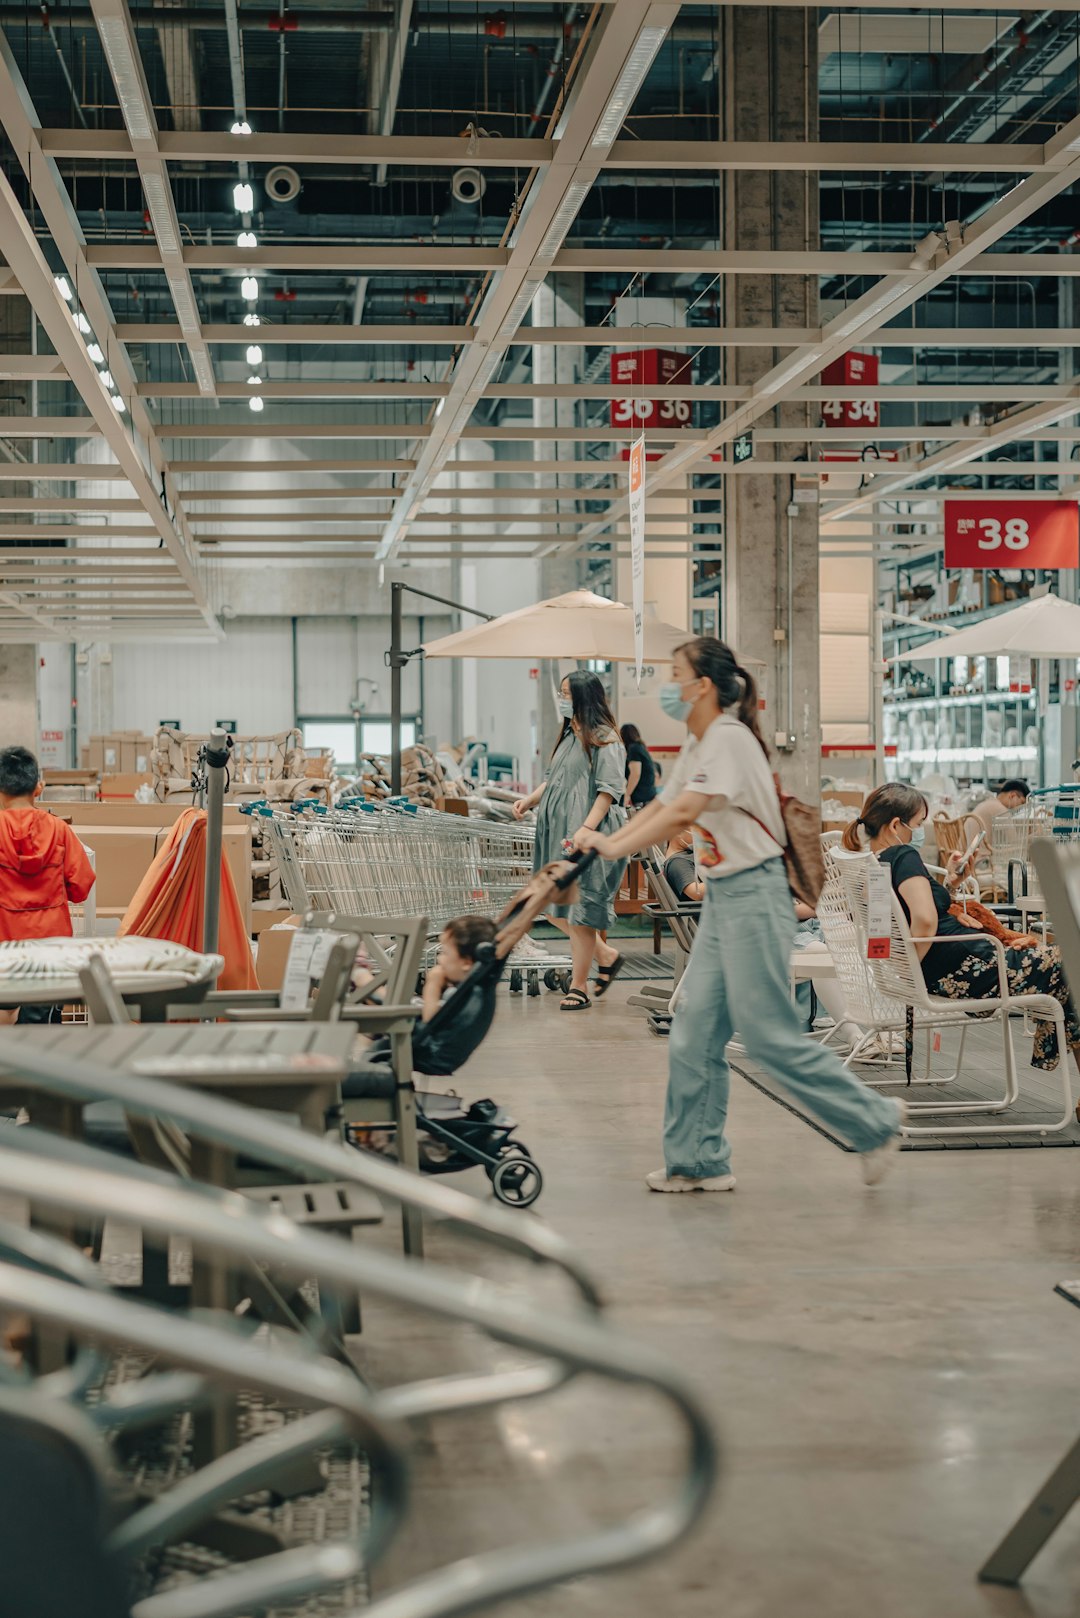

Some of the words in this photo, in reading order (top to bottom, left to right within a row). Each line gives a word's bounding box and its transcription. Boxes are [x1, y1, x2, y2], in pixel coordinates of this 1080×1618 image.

[615, 398, 654, 422] 36
[660, 399, 690, 421] 36
[848, 399, 877, 423] 34
[978, 518, 1030, 550] 38
